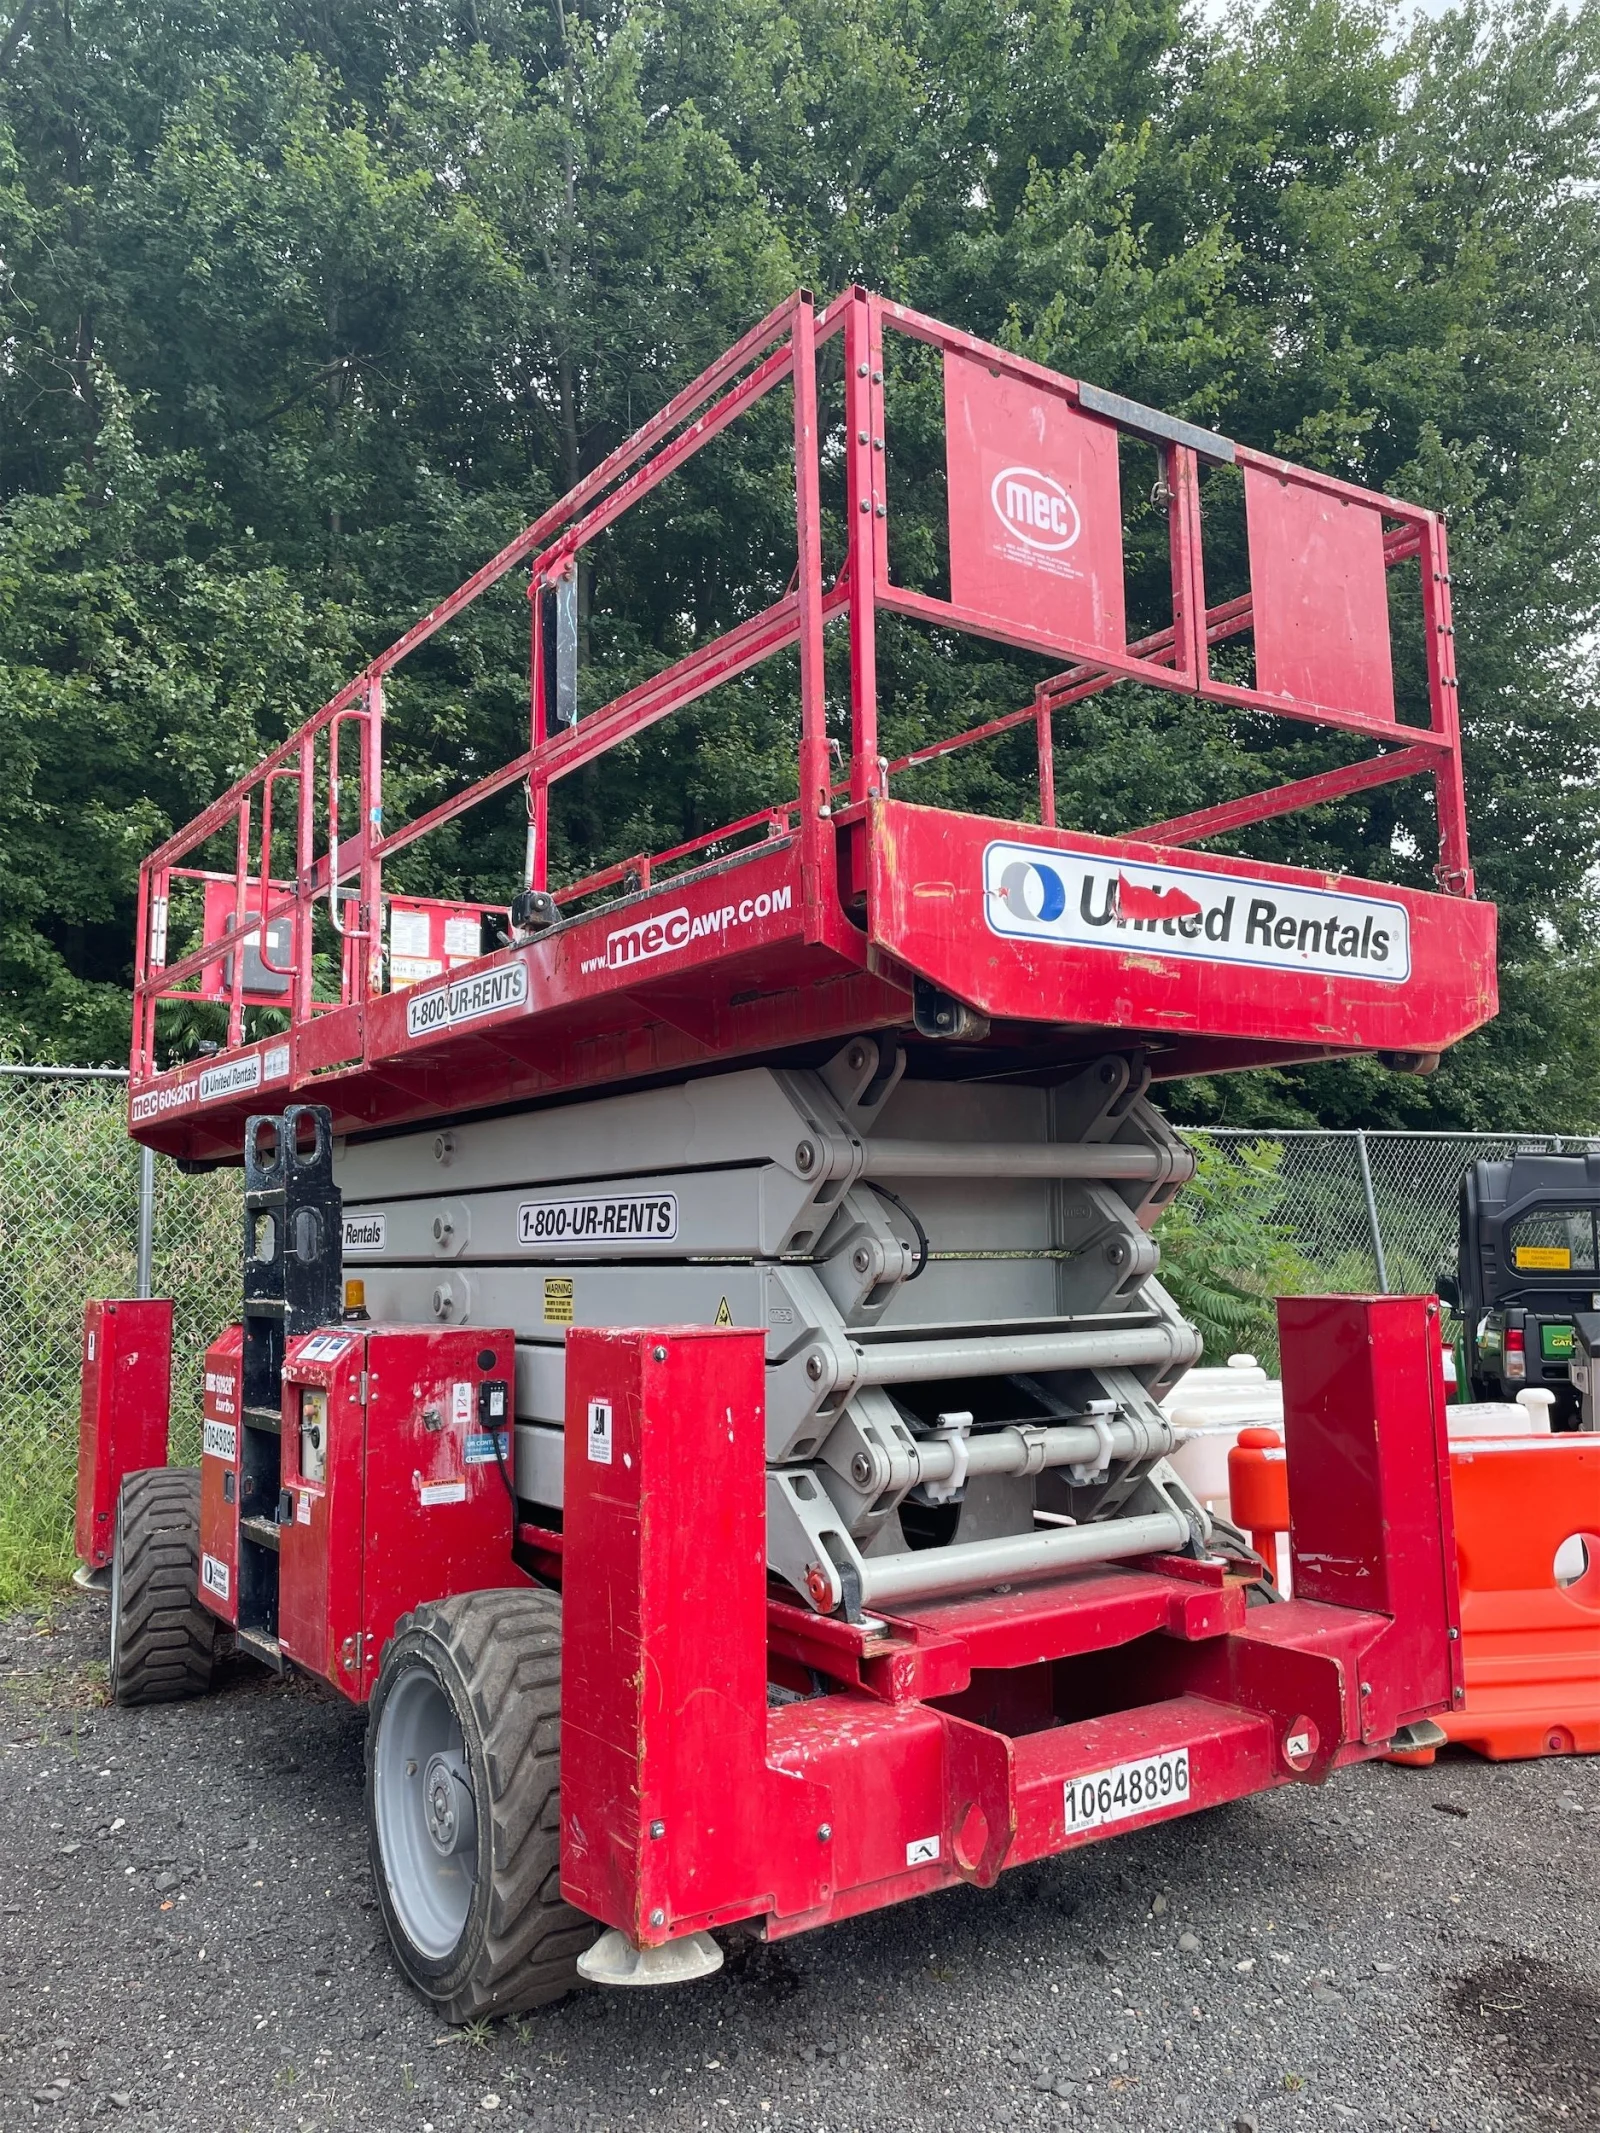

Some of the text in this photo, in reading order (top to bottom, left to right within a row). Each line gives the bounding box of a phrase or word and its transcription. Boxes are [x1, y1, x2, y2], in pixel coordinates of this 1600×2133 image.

[1006, 481, 1067, 536] mec
[1080, 875, 1390, 962] Ued Rentals
[411, 969, 523, 1028] 1-800-UR-RENTS
[209, 1074, 232, 1093] United
[231, 1064, 257, 1087] Rentals
[158, 1080, 198, 1111] 6092RT
[345, 1222, 381, 1244] Rentals
[522, 1202, 671, 1237] 1-800-UR-RENTS
[546, 1283, 572, 1294] WARNING
[215, 1397, 235, 1414] turbo
[1066, 1757, 1188, 1822] 10648896
